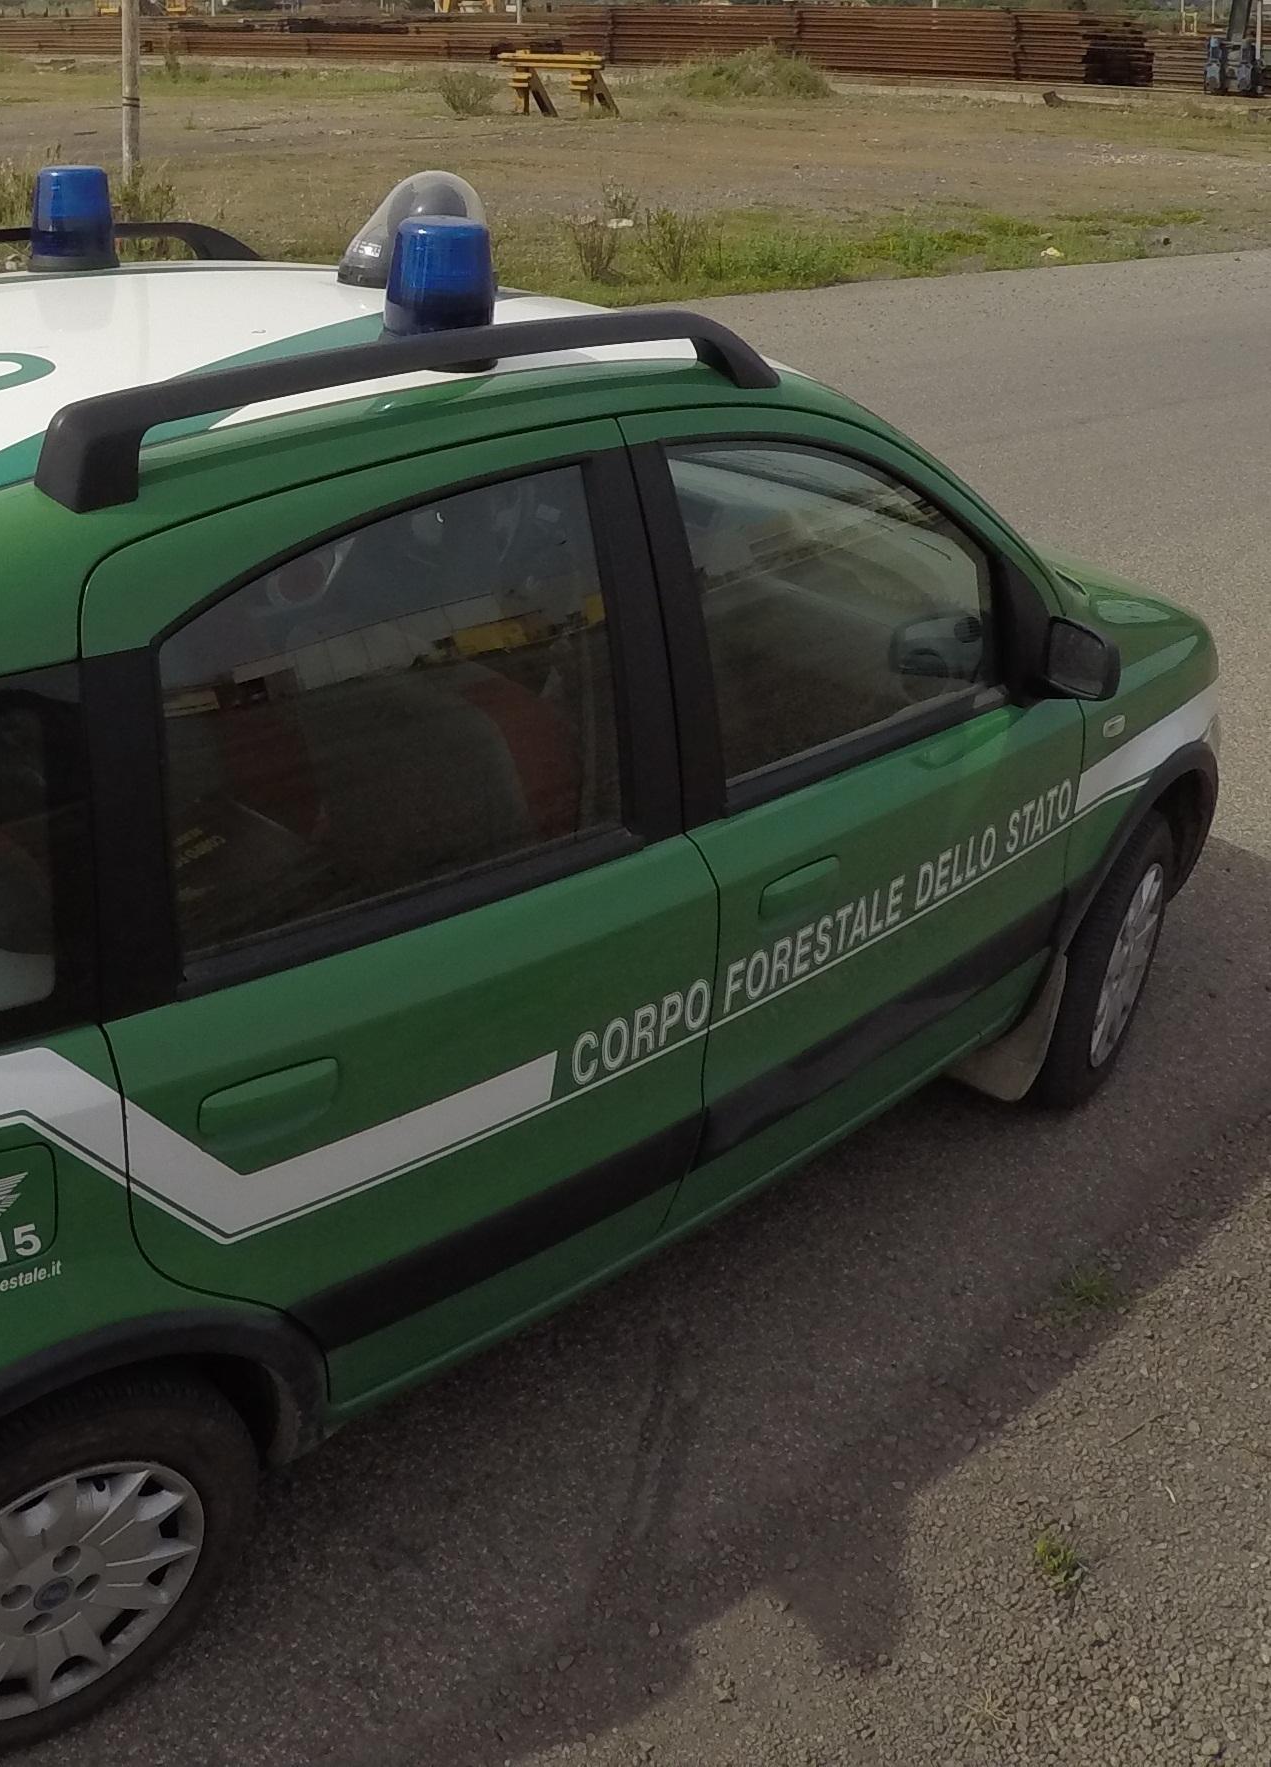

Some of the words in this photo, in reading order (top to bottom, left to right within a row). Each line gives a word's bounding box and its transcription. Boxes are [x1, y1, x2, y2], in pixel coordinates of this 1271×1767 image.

[572, 978, 710, 1085] CORPO
[723, 875, 903, 1013] FORESTALE
[914, 825, 996, 909] DELLO
[1005, 779, 1072, 855] STATO
